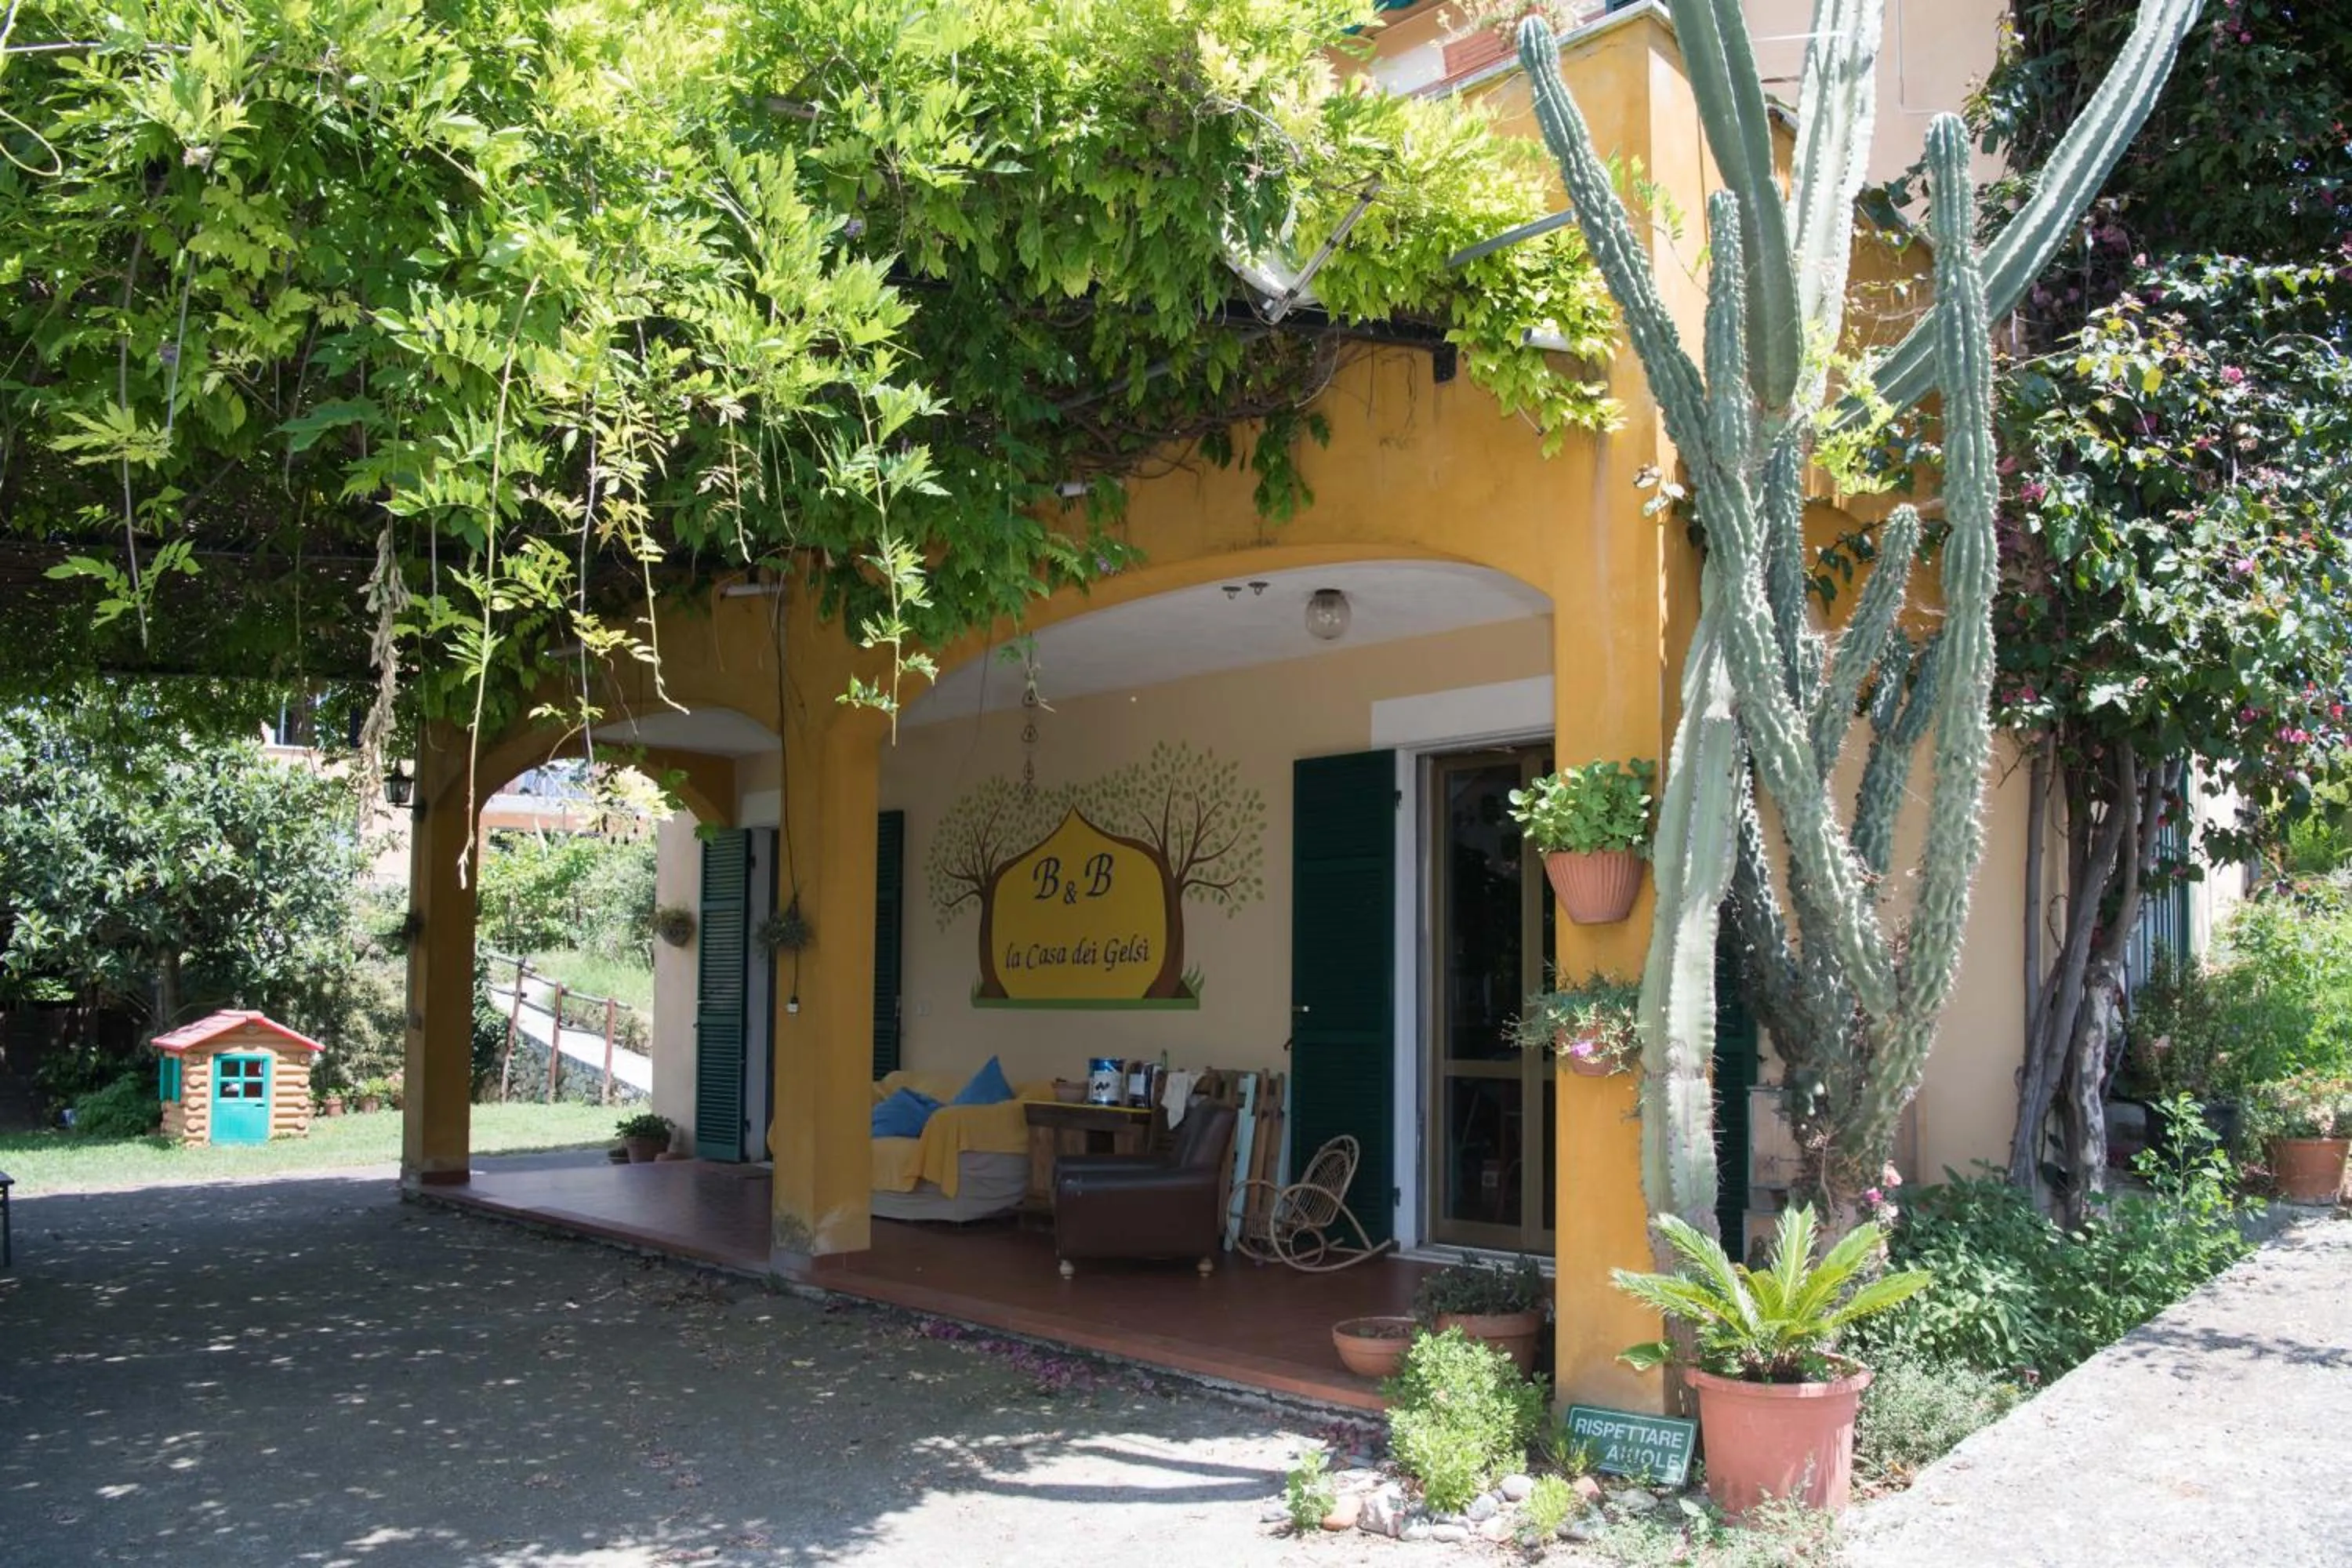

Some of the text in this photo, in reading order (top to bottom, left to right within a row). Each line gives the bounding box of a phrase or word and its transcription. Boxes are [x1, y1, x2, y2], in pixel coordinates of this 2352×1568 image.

[1033, 852, 1114, 905] B & B
[1006, 934, 1150, 971] la Casa dei Gelsi
[1574, 1417, 1685, 1450] RISPETTARE
